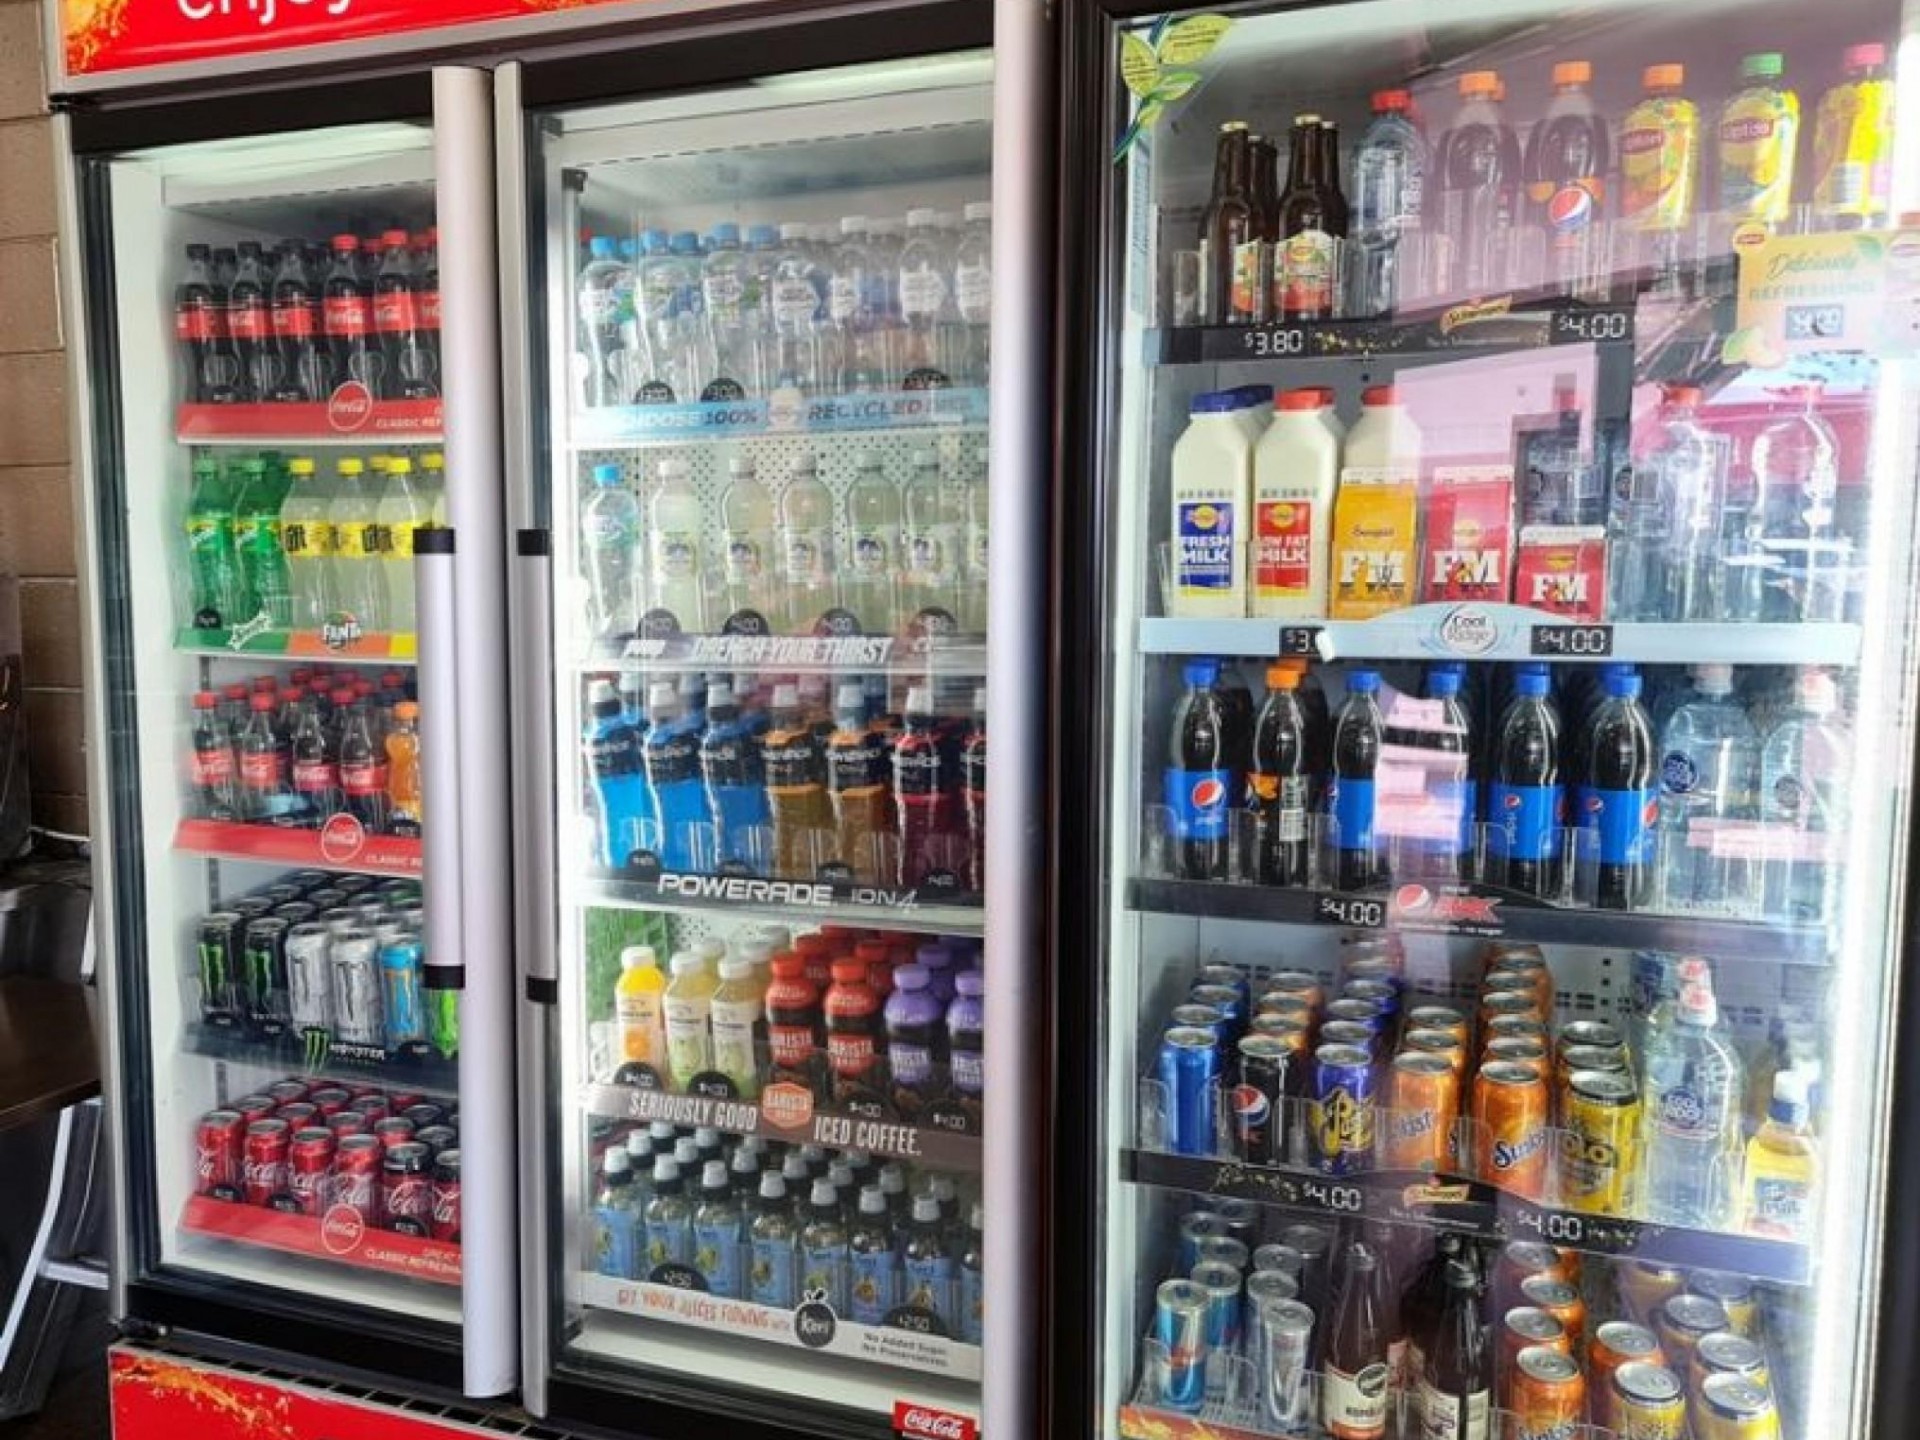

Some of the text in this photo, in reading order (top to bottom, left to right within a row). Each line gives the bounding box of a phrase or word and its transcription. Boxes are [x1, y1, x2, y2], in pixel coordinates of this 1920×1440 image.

[1558, 312, 1626, 339] $4.00
[1245, 329, 1303, 355] $3.80
[704, 408, 757, 425] 100%
[808, 399, 922, 422] RECYCLED
[1180, 548, 1229, 563] MILK
[1258, 549, 1307, 564] MILK
[1540, 628, 1605, 653] $4.00
[657, 873, 834, 906] POWERADE
[1321, 898, 1381, 927] $4.00
[629, 1091, 758, 1130] SERIOUSLY GOOD
[813, 1116, 922, 1156] ICED COFFEE.
[1302, 1182, 1362, 1212] $4.00
[1516, 1210, 1583, 1241] $4.00
